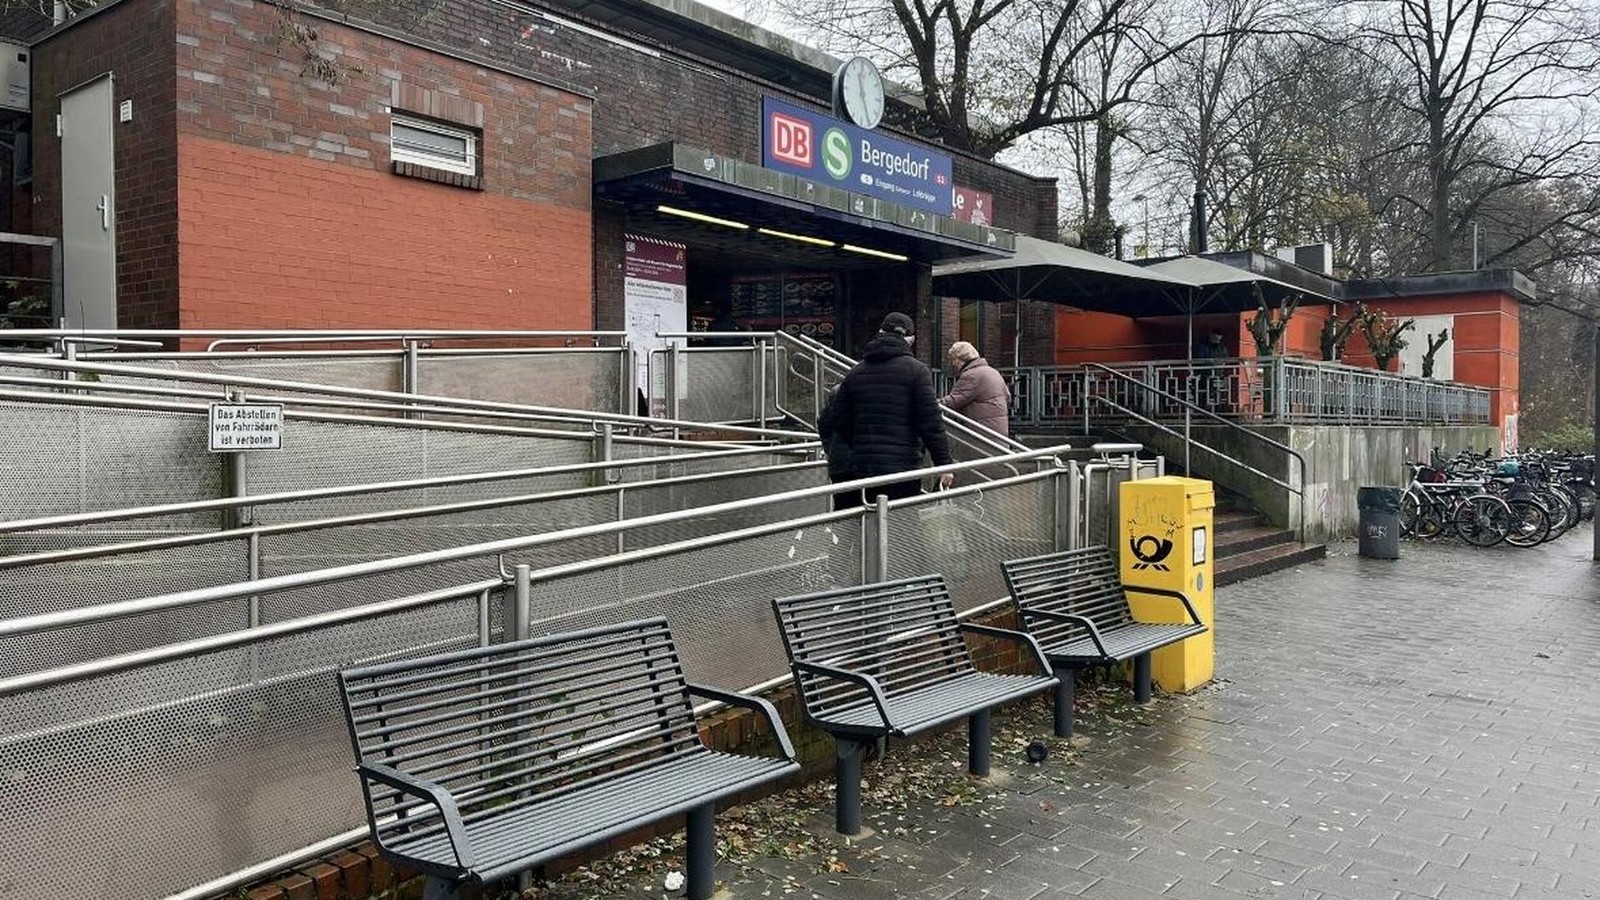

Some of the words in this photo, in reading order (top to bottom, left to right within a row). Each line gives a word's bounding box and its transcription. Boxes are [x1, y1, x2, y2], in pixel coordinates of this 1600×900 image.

[776, 120, 808, 158] DB
[827, 131, 848, 176] S
[861, 139, 930, 181] Bergedorf
[217, 409, 233, 419] Das
[236, 409, 277, 419] Abstellen
[215, 423, 230, 432] von
[233, 421, 279, 432] Fahrrädern
[221, 434, 232, 445] ist
[236, 435, 273, 445] verboten
